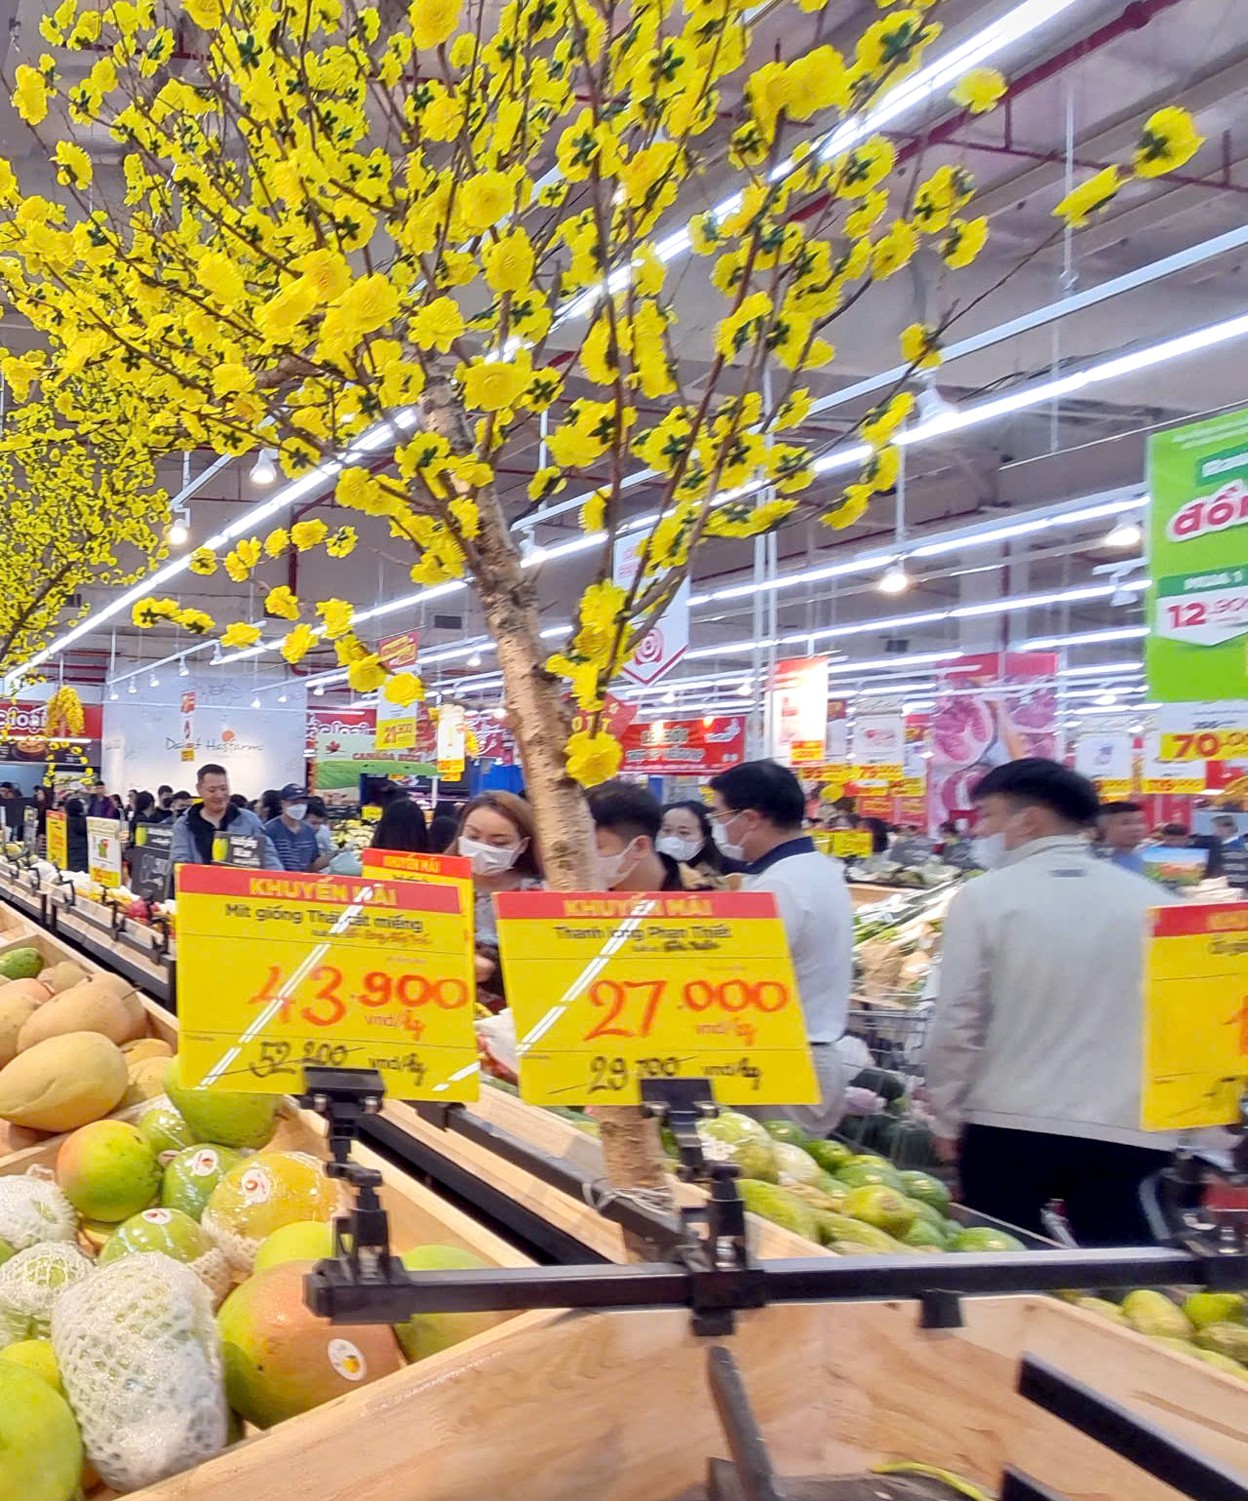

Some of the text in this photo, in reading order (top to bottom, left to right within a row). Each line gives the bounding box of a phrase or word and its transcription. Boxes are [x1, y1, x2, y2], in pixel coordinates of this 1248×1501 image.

[165, 737, 201, 750] Dat
[249, 877, 348, 902] KHUYẾN
[255, 904, 303, 923] giống
[373, 914, 423, 932] miếng
